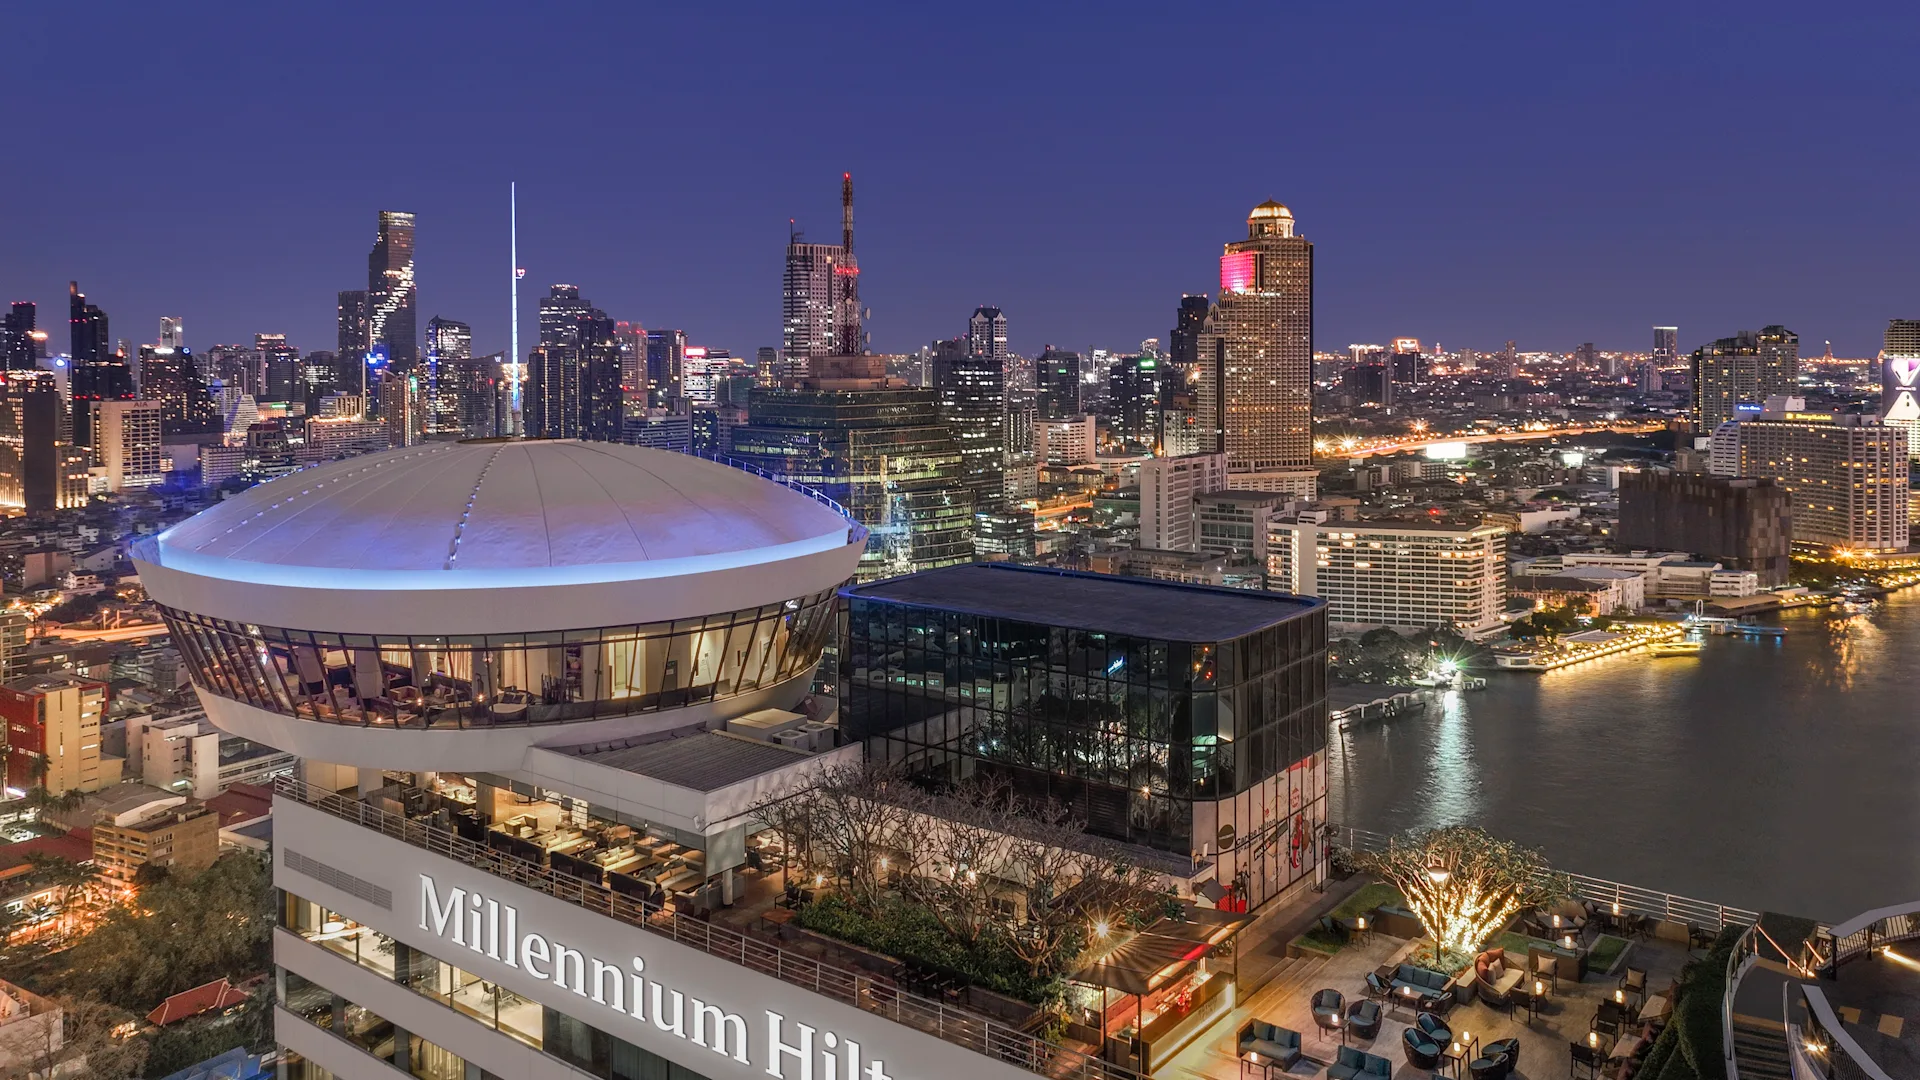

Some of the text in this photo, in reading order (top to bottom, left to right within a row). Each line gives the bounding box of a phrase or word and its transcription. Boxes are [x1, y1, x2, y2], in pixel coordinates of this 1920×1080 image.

[1236, 829, 1257, 846] Carbe
[1258, 818, 1276, 833] Hlton
[419, 873, 751, 1067] Millennium
